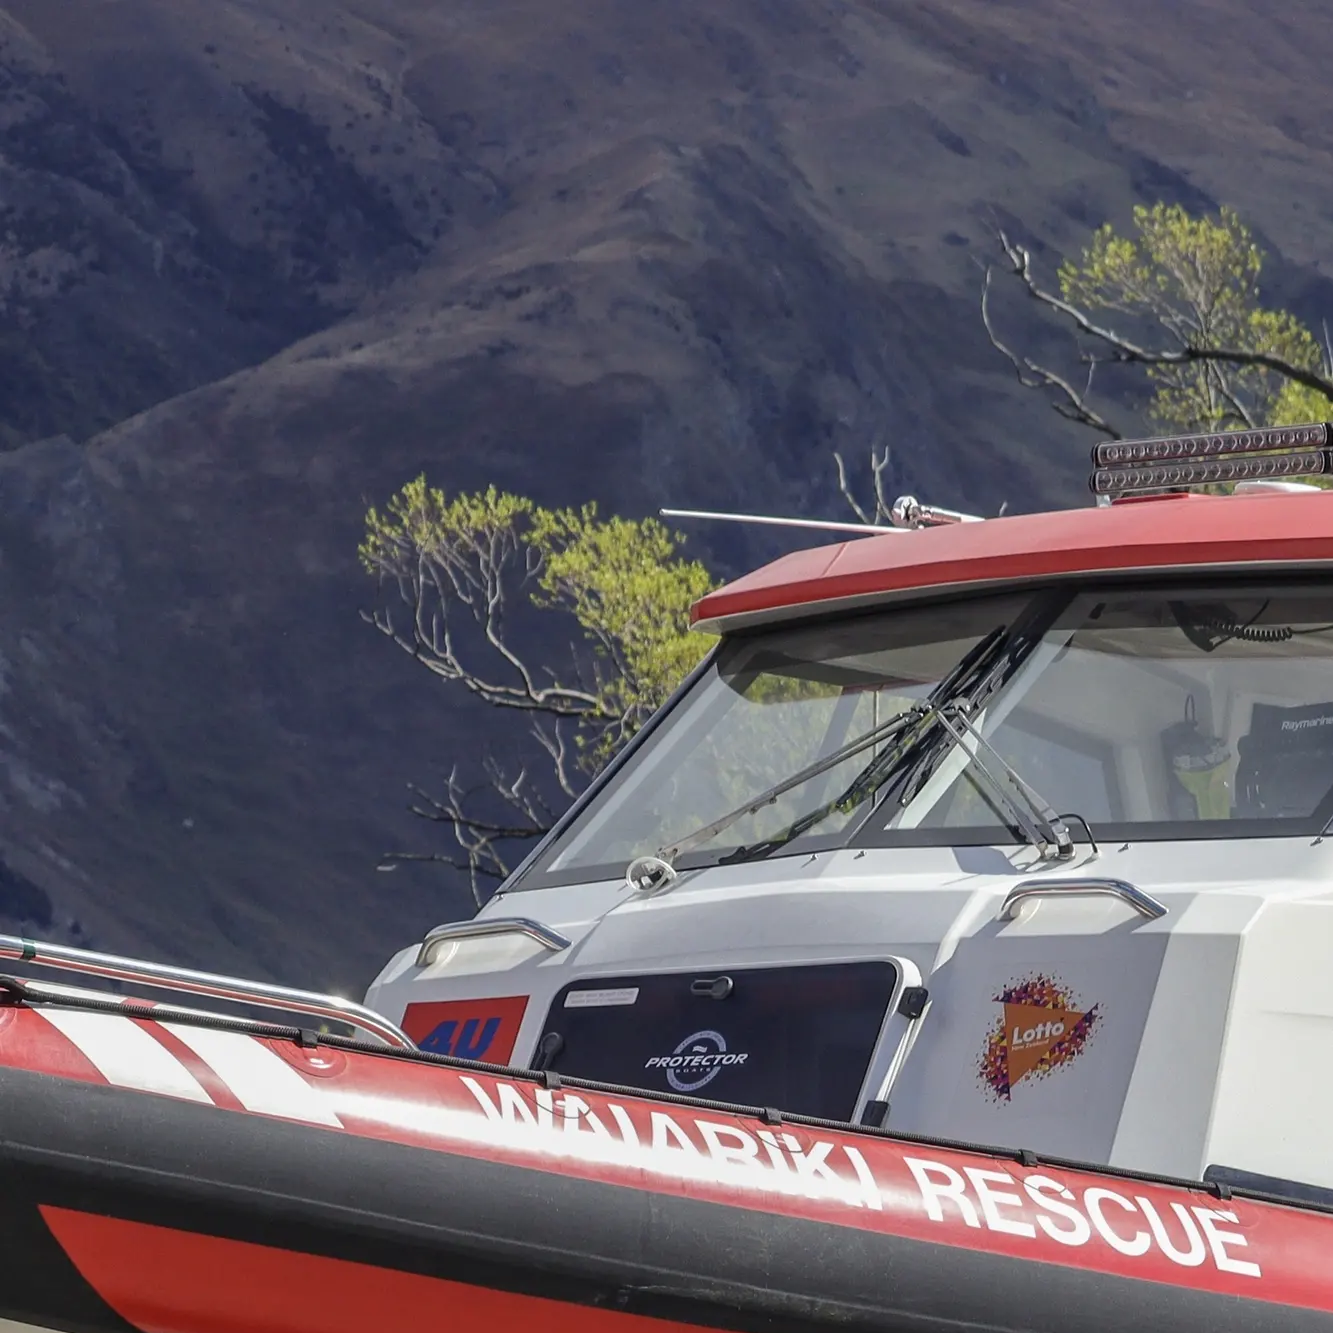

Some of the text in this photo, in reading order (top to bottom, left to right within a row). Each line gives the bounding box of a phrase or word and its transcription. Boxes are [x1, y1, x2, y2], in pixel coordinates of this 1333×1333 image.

[1012, 1021, 1065, 1046] Lotto
[644, 1053, 749, 1068] PROTECTOR
[904, 1156, 1262, 1278] RESCUE
